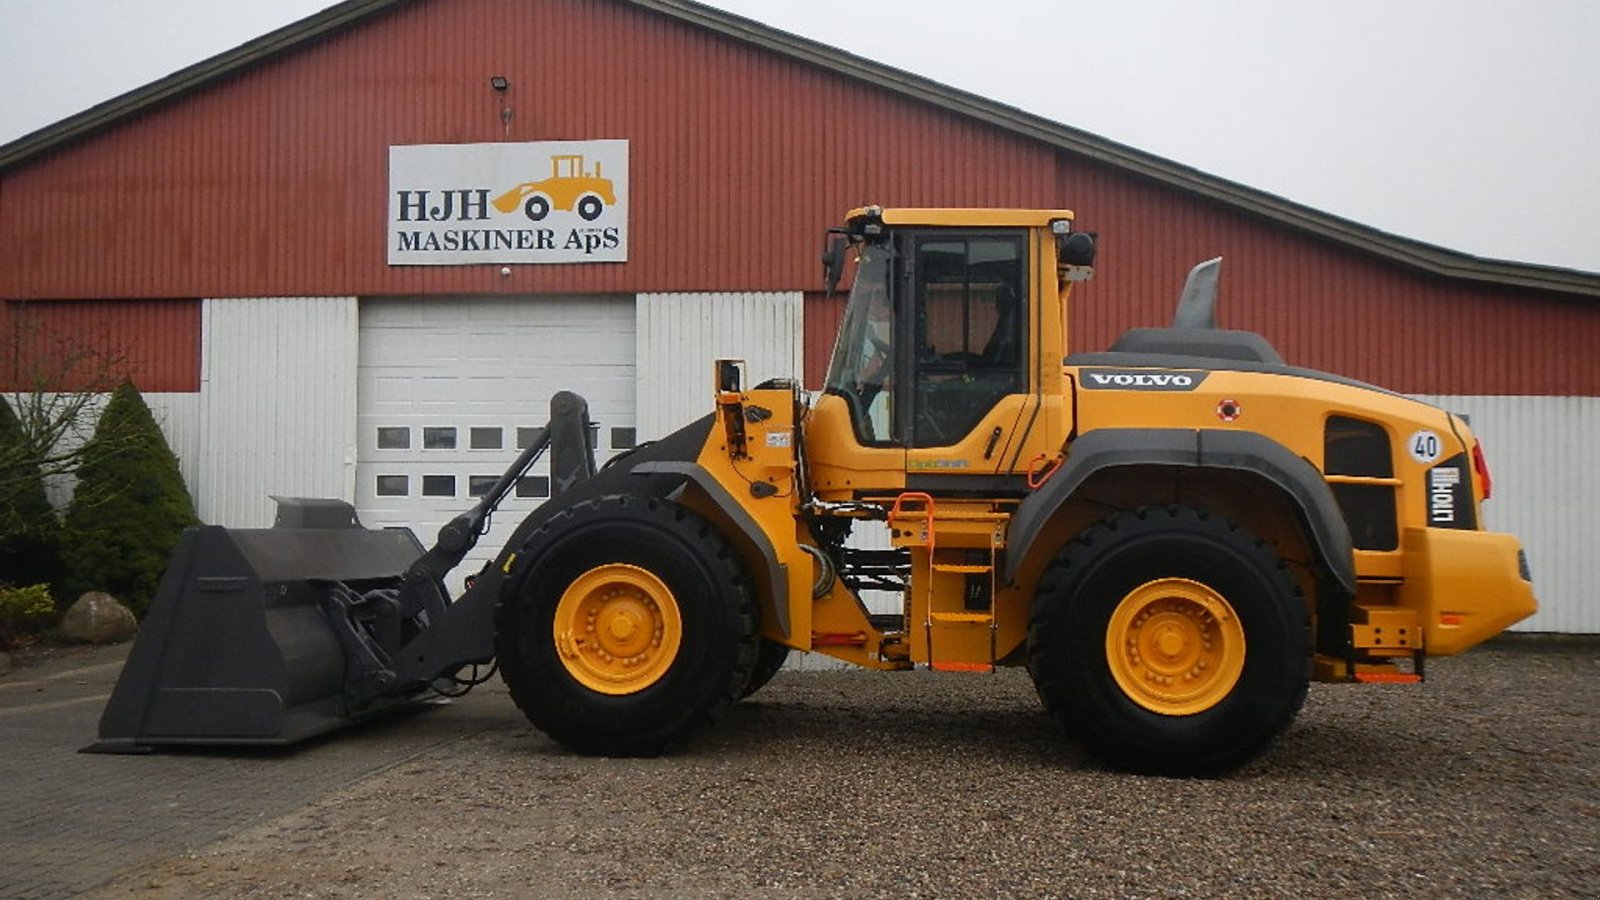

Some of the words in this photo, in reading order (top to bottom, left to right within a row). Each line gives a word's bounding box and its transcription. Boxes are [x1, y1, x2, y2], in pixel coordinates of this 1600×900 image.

[396, 189, 491, 221] HJH
[397, 229, 556, 251] MASKINER
[563, 227, 620, 254] ApS
[1089, 373, 1192, 386] VOLVO
[1415, 435, 1437, 458] 40
